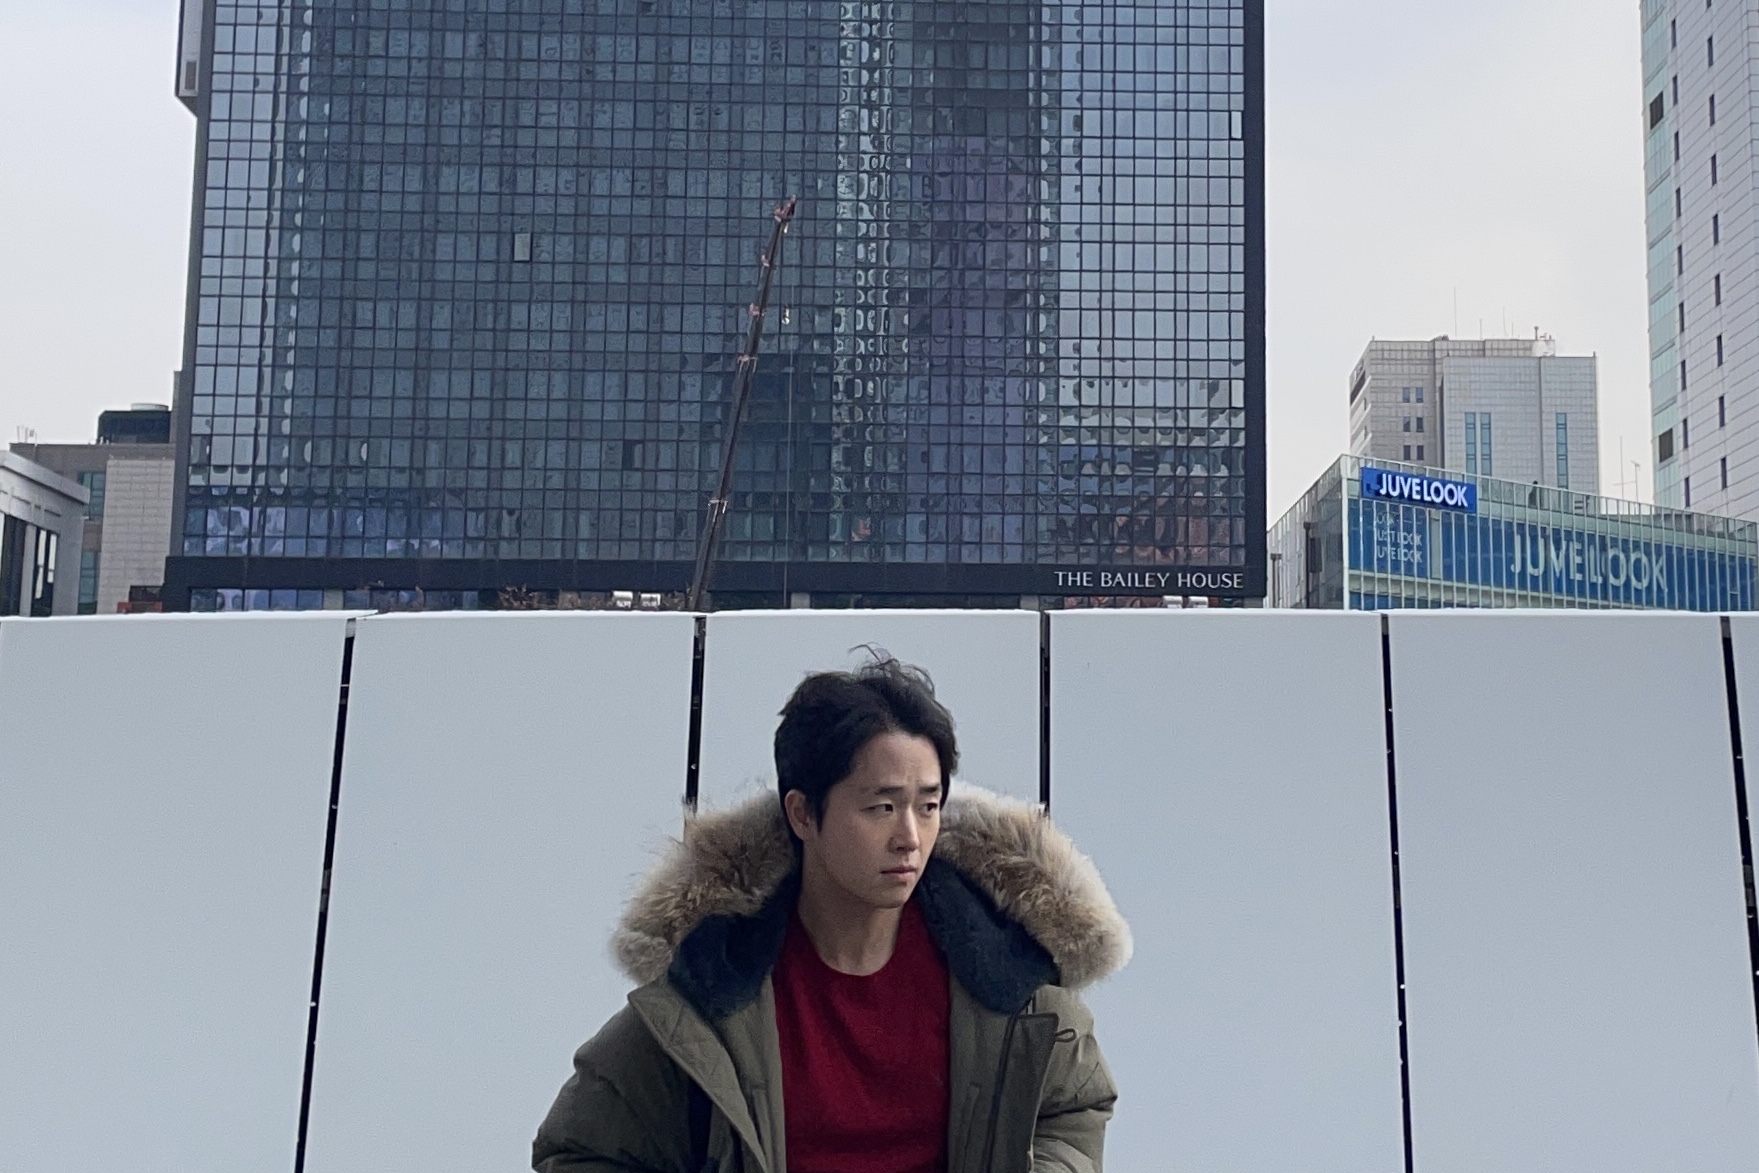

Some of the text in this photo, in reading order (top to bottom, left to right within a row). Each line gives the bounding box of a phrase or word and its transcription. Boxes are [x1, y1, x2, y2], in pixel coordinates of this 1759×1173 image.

[1379, 473, 1468, 507] JUVELOOK
[1054, 571, 1244, 589] THE BAILEY HOUSE
